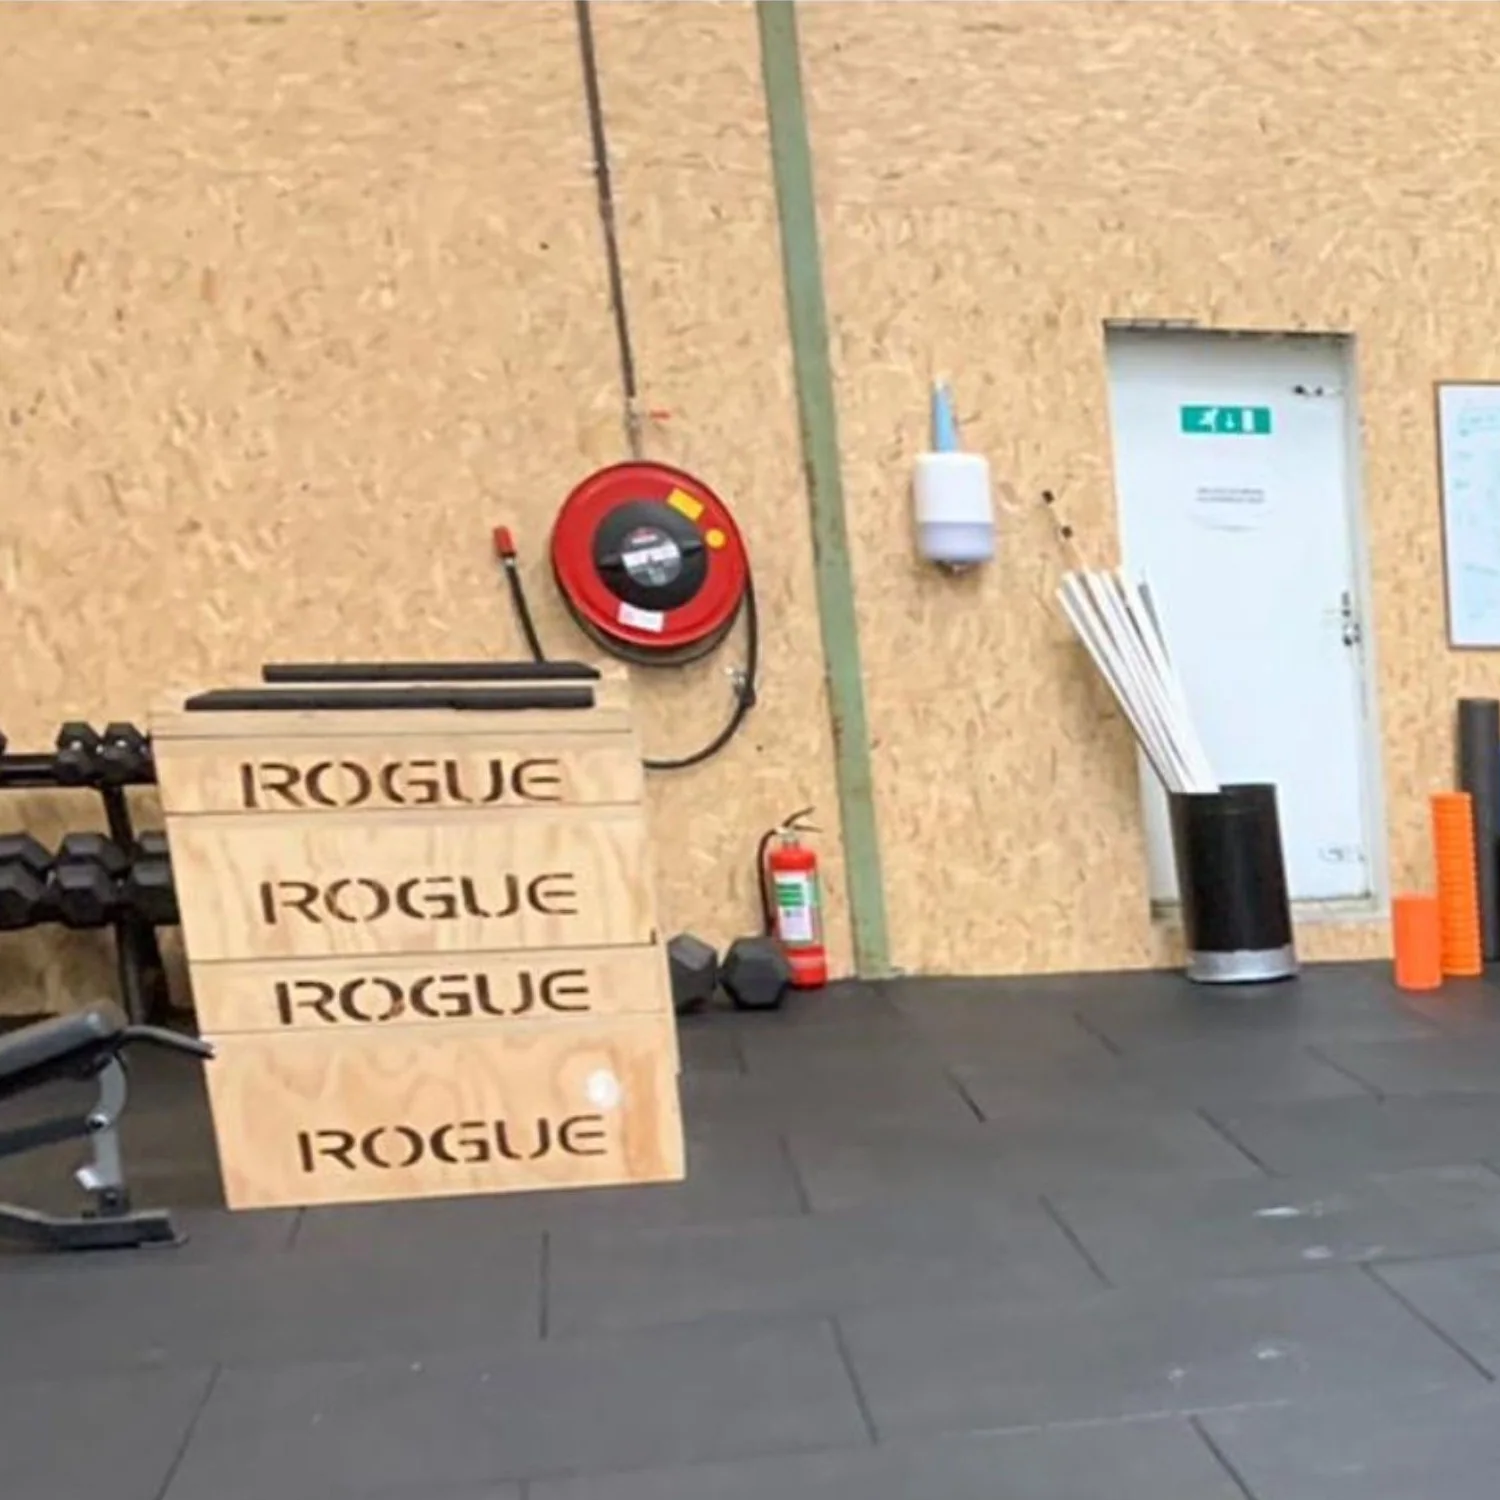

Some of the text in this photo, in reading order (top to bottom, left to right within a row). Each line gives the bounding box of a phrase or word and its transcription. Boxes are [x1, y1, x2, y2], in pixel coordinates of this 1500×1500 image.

[240, 758, 562, 808] ROGUE
[260, 873, 577, 924] ROGUE
[275, 969, 590, 1025] ROGUE
[298, 1115, 607, 1173] ROGUE
